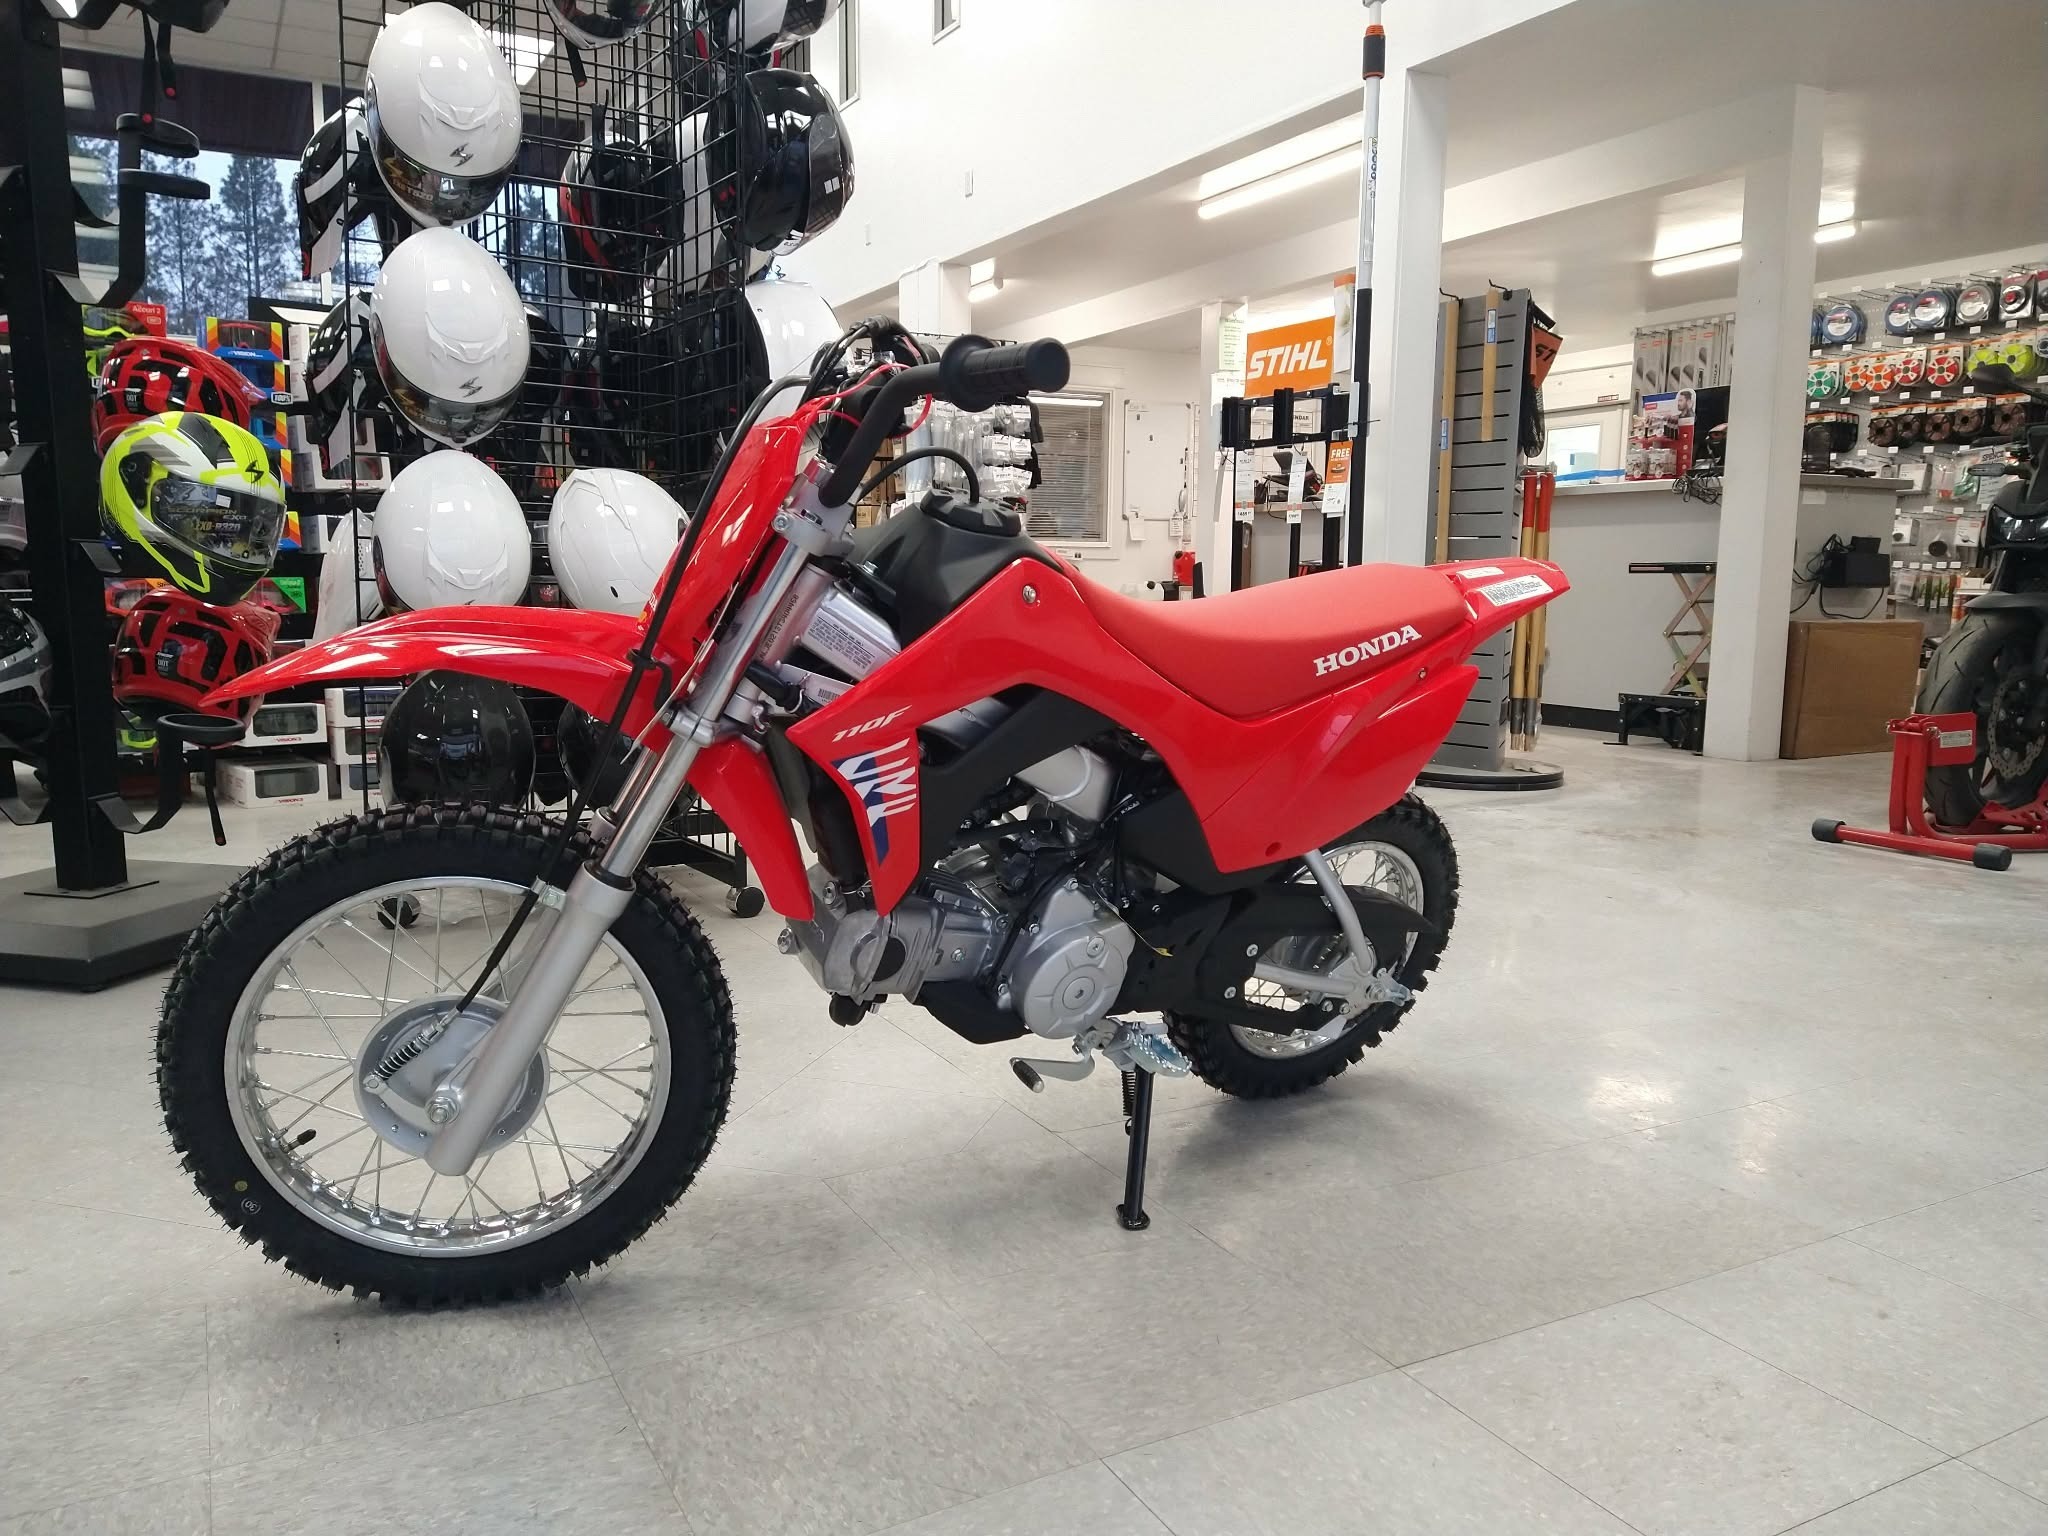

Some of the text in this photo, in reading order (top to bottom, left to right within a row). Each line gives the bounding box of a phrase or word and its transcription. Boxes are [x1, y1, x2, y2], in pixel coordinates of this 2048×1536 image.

[1247, 340, 1327, 380] STIHL
[1331, 448, 1351, 459] FREE
[167, 506, 237, 515] SCORPION
[1313, 624, 1422, 678] HONDA
[832, 705, 912, 743] 110F
[837, 737, 917, 828] CRF
